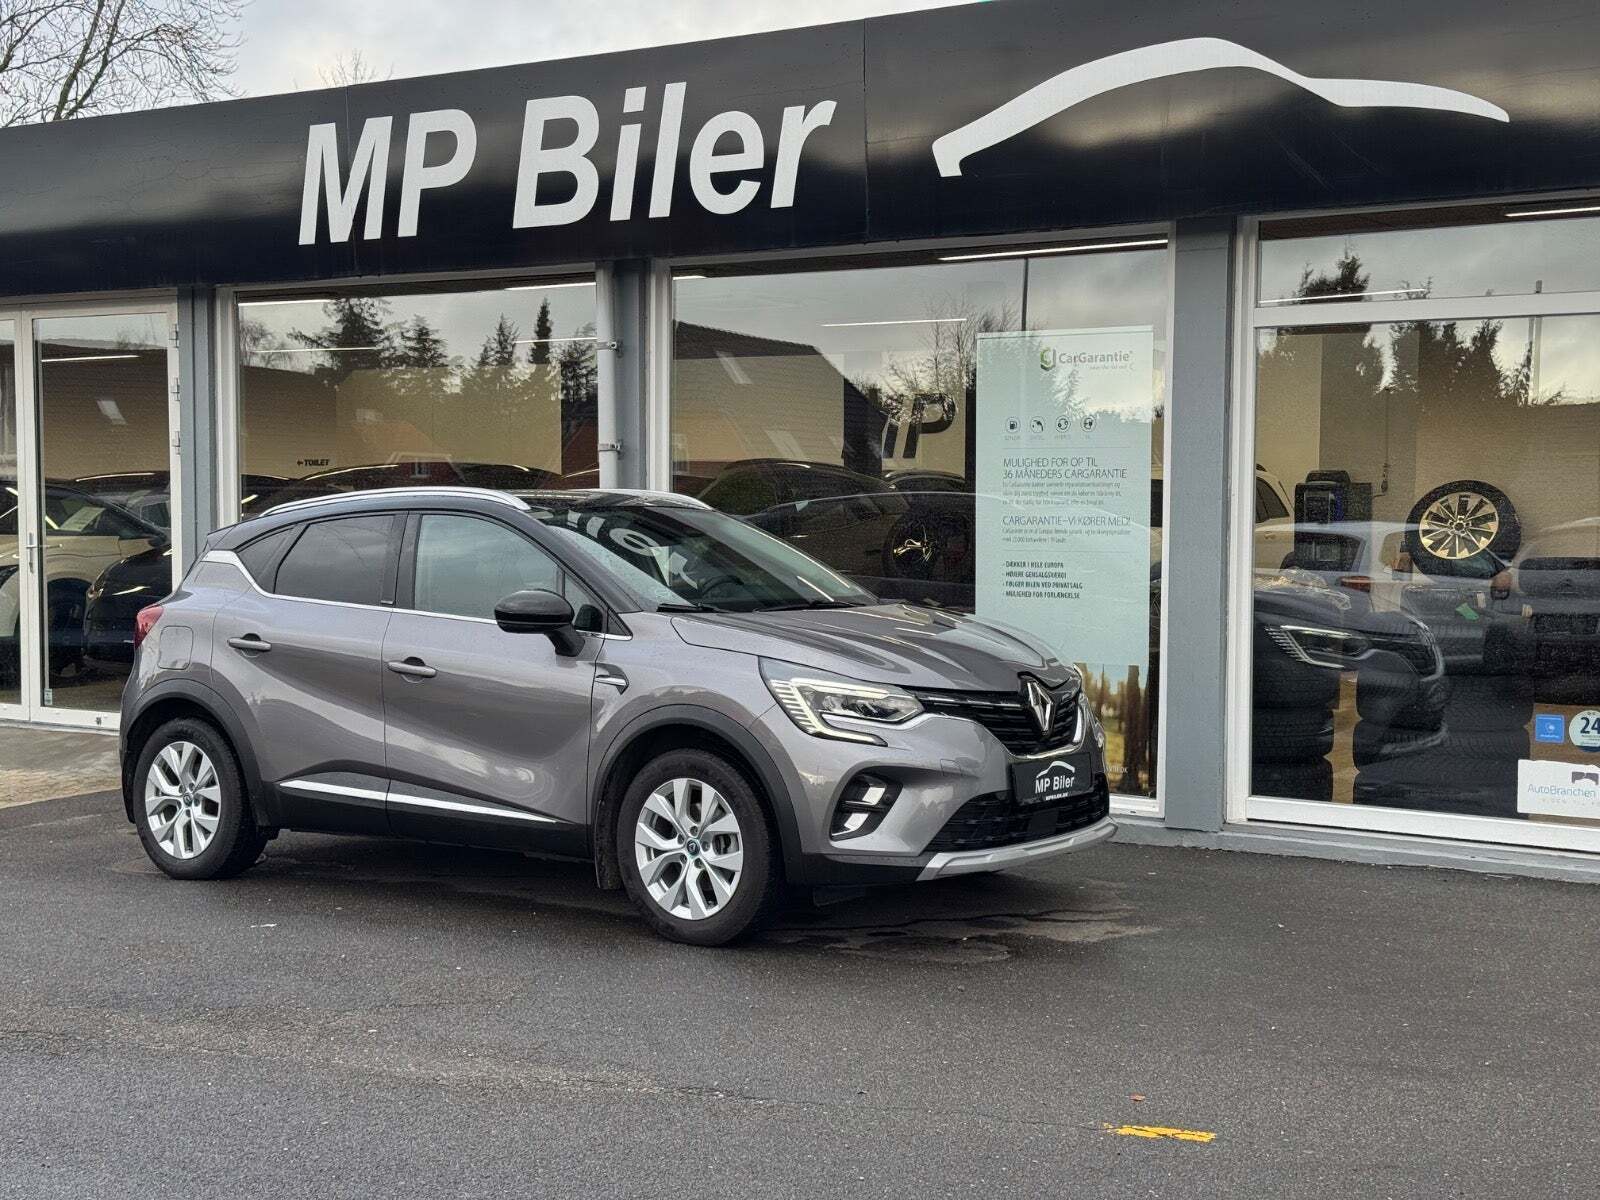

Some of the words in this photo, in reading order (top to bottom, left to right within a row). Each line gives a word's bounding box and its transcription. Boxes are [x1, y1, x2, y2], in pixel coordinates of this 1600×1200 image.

[298, 108, 477, 246] MP
[512, 81, 838, 229] Biler
[1003, 458, 1049, 468] MULIGHED
[1051, 457, 1069, 467] FOR
[1070, 457, 1084, 467] OP
[1085, 456, 1098, 467] TIL
[1003, 469, 1013, 479] 36
[1015, 468, 1063, 479] MÅNEDERS
[1064, 468, 1128, 479] CARGARANTIE
[1079, 515, 1107, 526] KØRER
[1580, 716, 1600, 735] 24
[1035, 778, 1051, 794] MP
[1053, 775, 1075, 791] Biler
[1527, 784, 1596, 798] AutoBranchen
